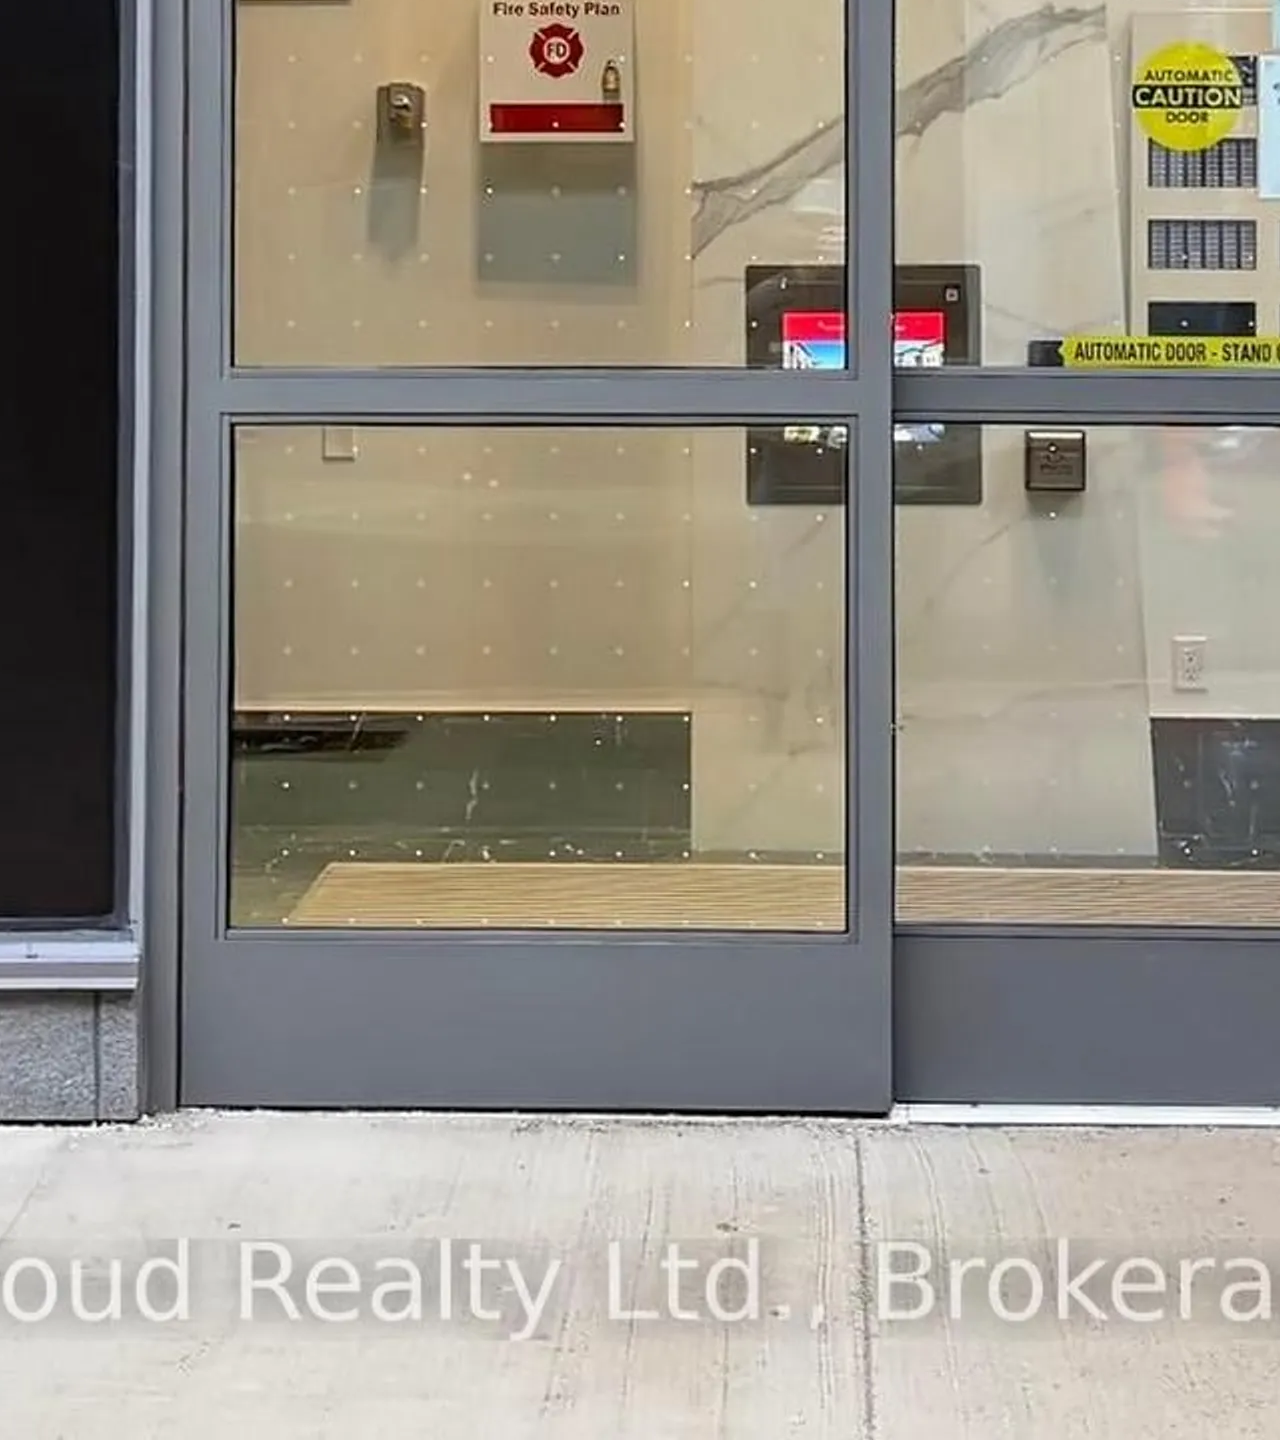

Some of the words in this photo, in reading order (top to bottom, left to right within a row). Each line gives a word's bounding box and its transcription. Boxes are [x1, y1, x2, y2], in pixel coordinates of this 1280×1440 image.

[492, 1, 524, 16] Fire
[528, 1, 580, 19] Safety
[583, 1, 621, 16] Plan
[546, 42, 567, 59] FD
[1144, 69, 1233, 82] AUTOMATIC
[1135, 87, 1242, 106] CAUTION
[1166, 111, 1208, 123] DOOR
[1074, 342, 1160, 361] AUTOMATIC
[1165, 342, 1207, 361] DOOR
[1222, 342, 1270, 362] STAND
